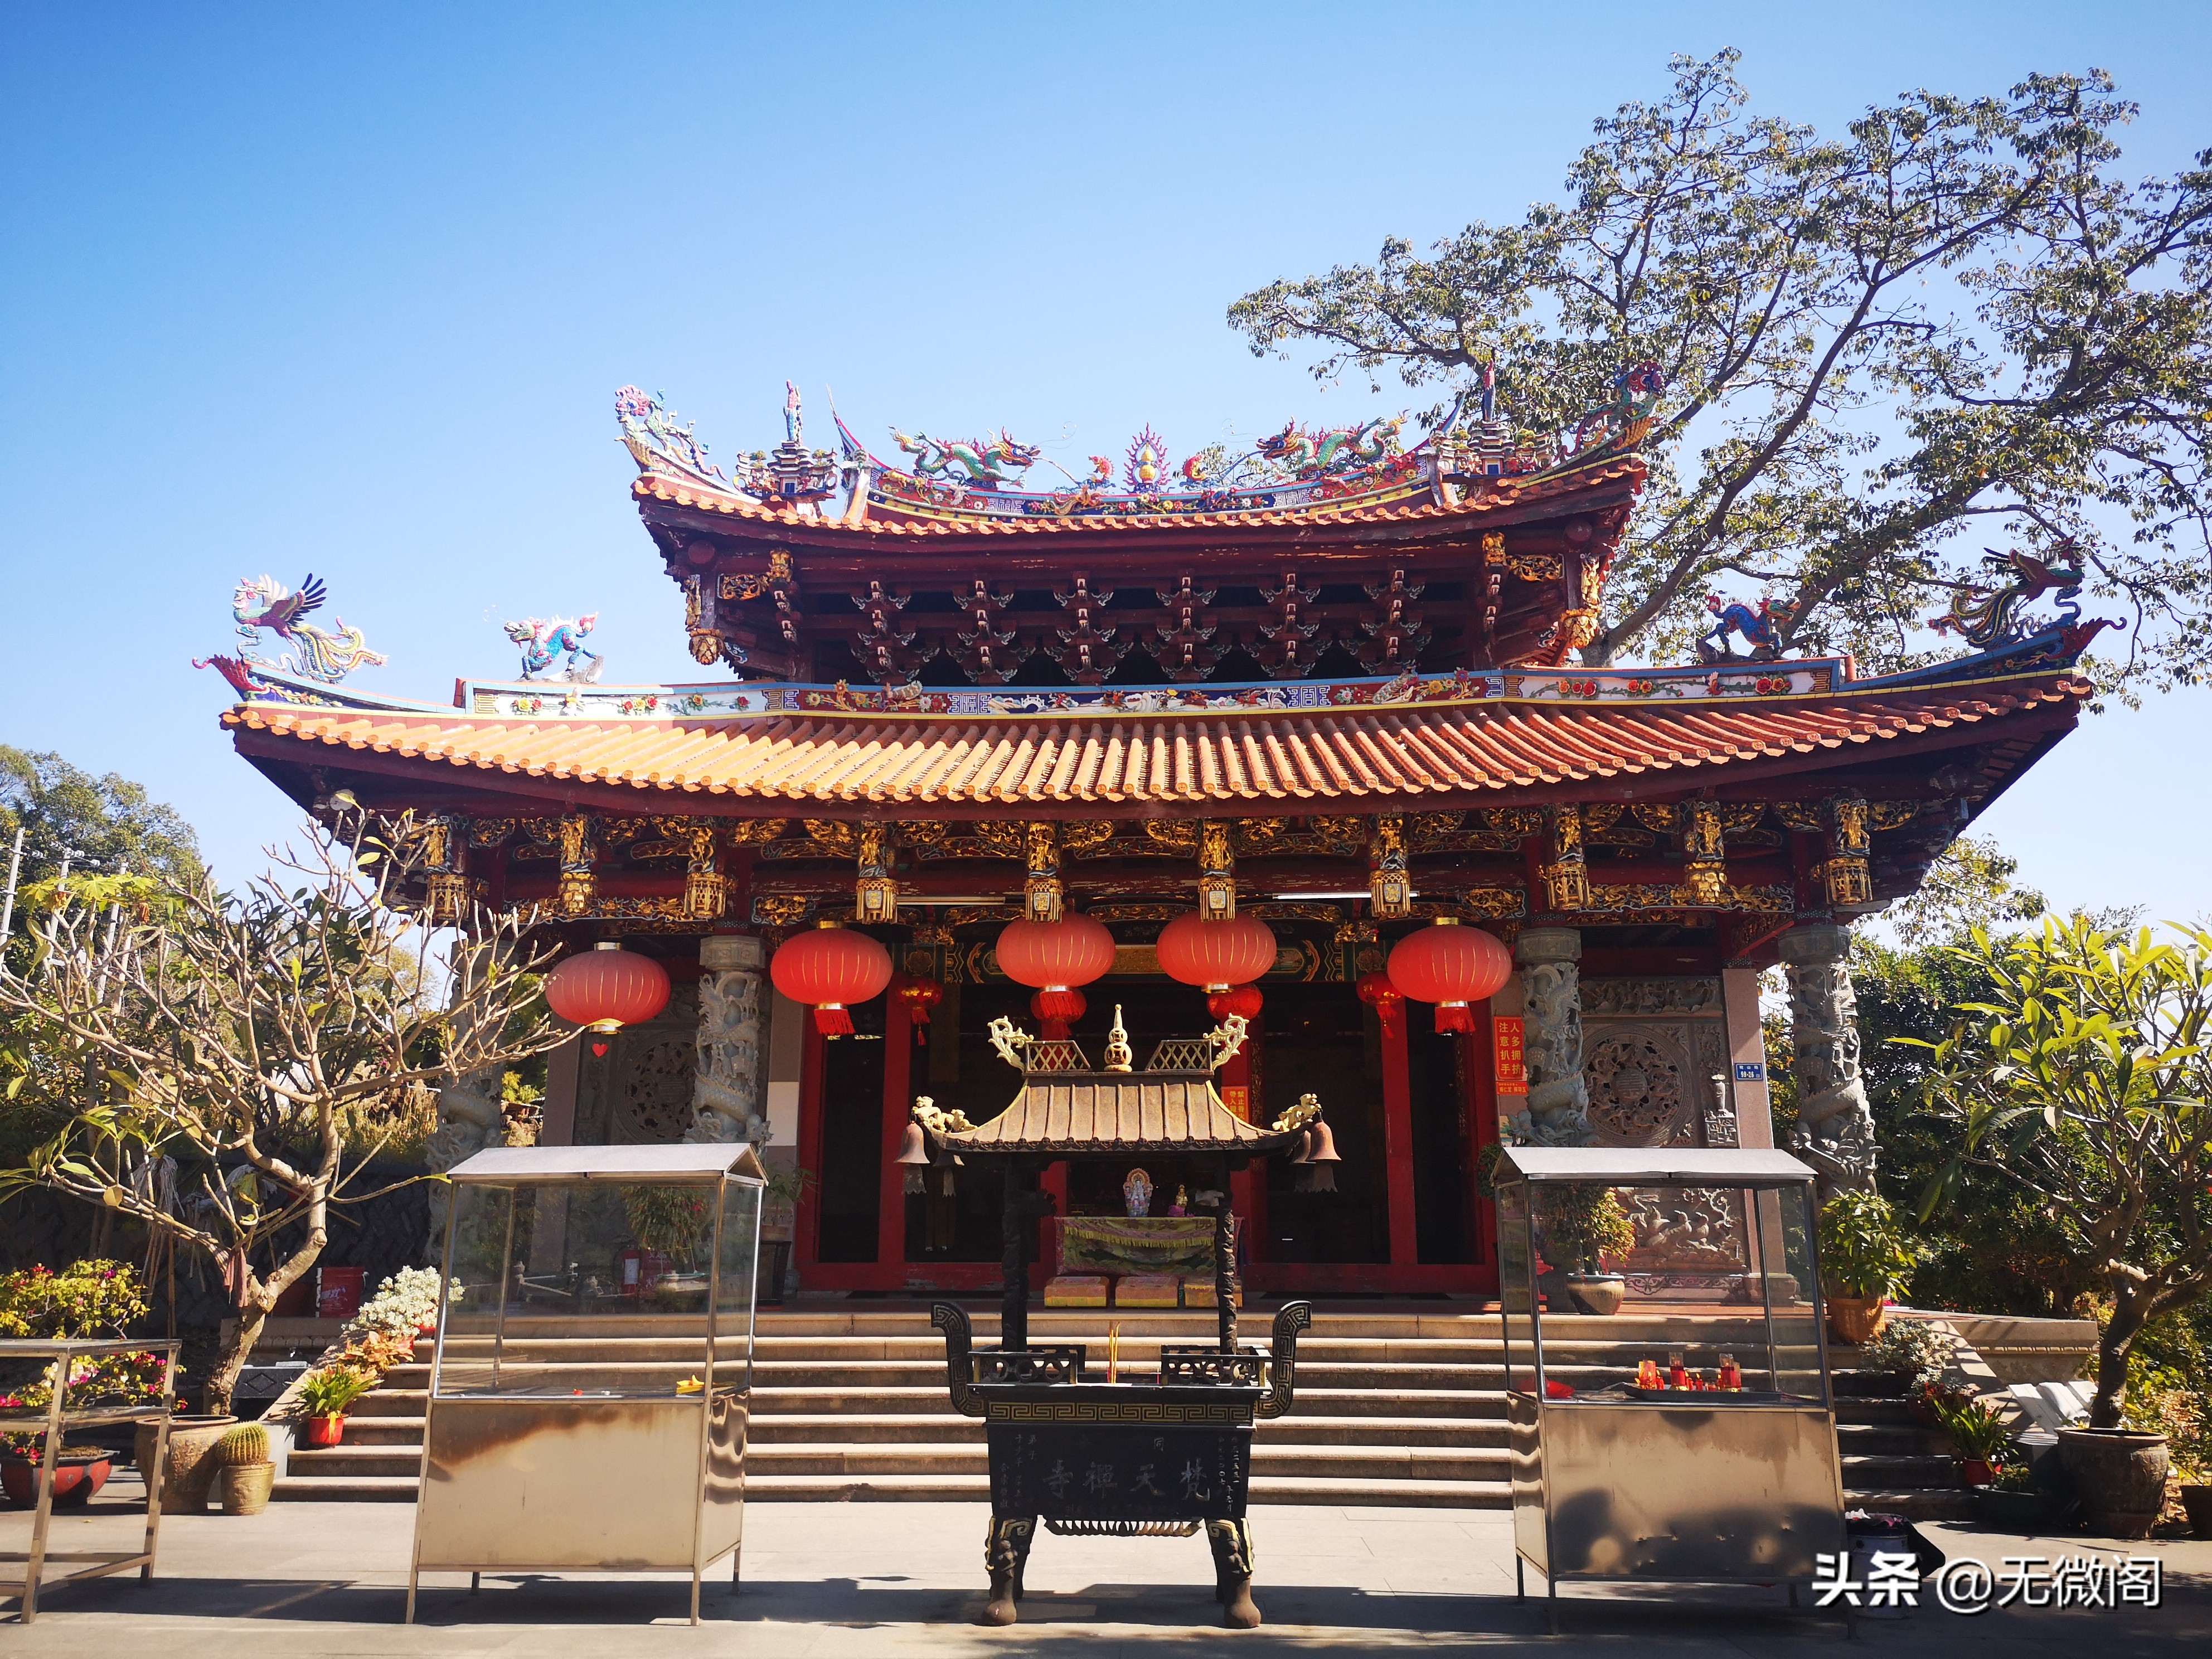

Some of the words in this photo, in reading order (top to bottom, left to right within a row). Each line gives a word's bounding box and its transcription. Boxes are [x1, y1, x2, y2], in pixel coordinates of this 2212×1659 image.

[1498, 1022, 1511, 1075] 注意扒手
[1510, 1022, 1521, 1074] 人多拥挤
